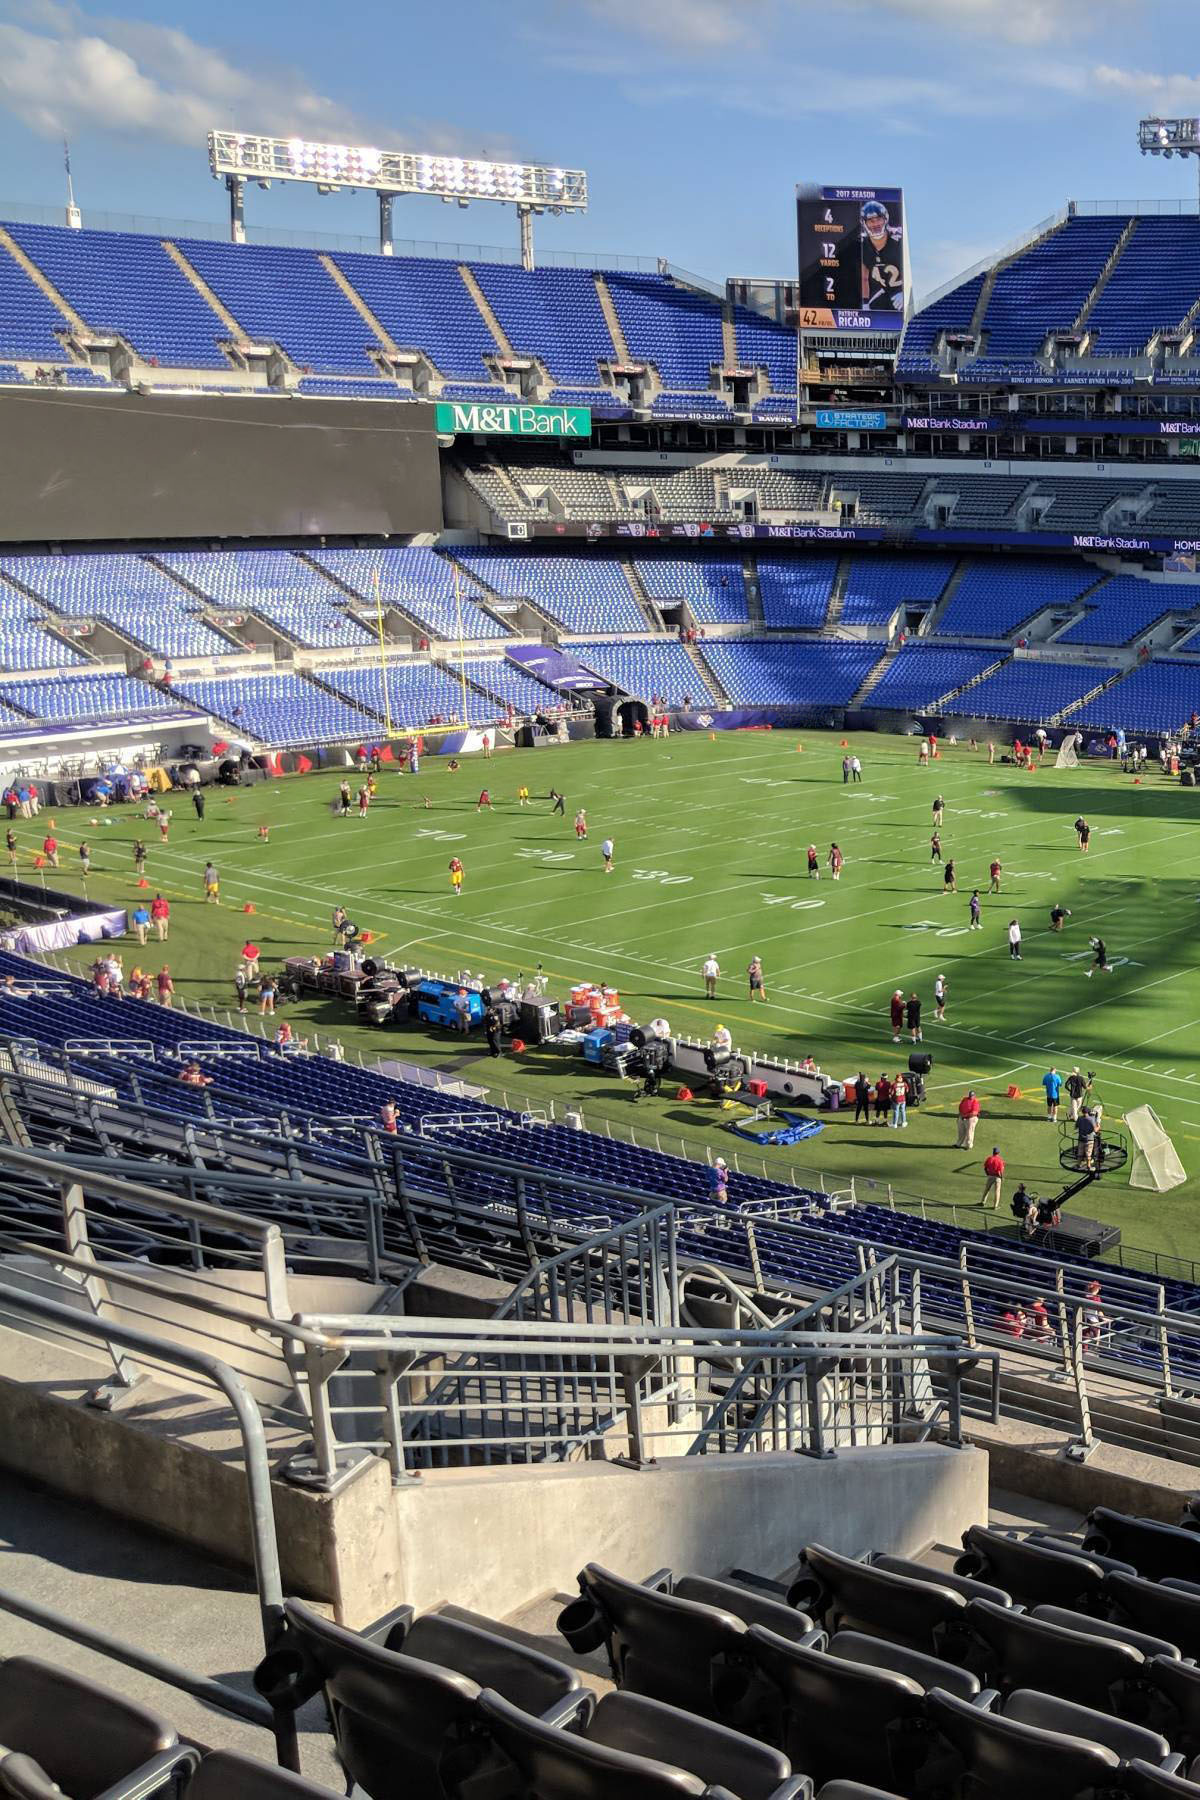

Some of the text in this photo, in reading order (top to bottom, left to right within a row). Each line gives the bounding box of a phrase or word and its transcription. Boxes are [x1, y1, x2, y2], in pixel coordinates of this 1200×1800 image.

[836, 190, 876, 198] 2017 SEASON
[824, 208, 834, 224] 4
[814, 224, 844, 233] RECEPTIONS
[822, 243, 836, 258] 12
[826, 278, 834, 292] 2
[803, 310, 818, 326] 42
[838, 318, 870, 328] RICARD
[452, 405, 578, 434] M&T Bank
[833, 412, 882, 420] STRATEGIC
[834, 420, 881, 428] FACTORY
[907, 418, 988, 430] M&T Bank Stadium
[1160, 422, 1182, 433] M&T
[768, 526, 856, 539] M&T Bank Stadium
[1074, 536, 1150, 549] M&T Bank Stadium
[1174, 540, 1200, 551] HOME
[415, 828, 468, 841] 10
[513, 847, 576, 862] 20
[631, 869, 694, 885] 30
[759, 892, 826, 910] 40
